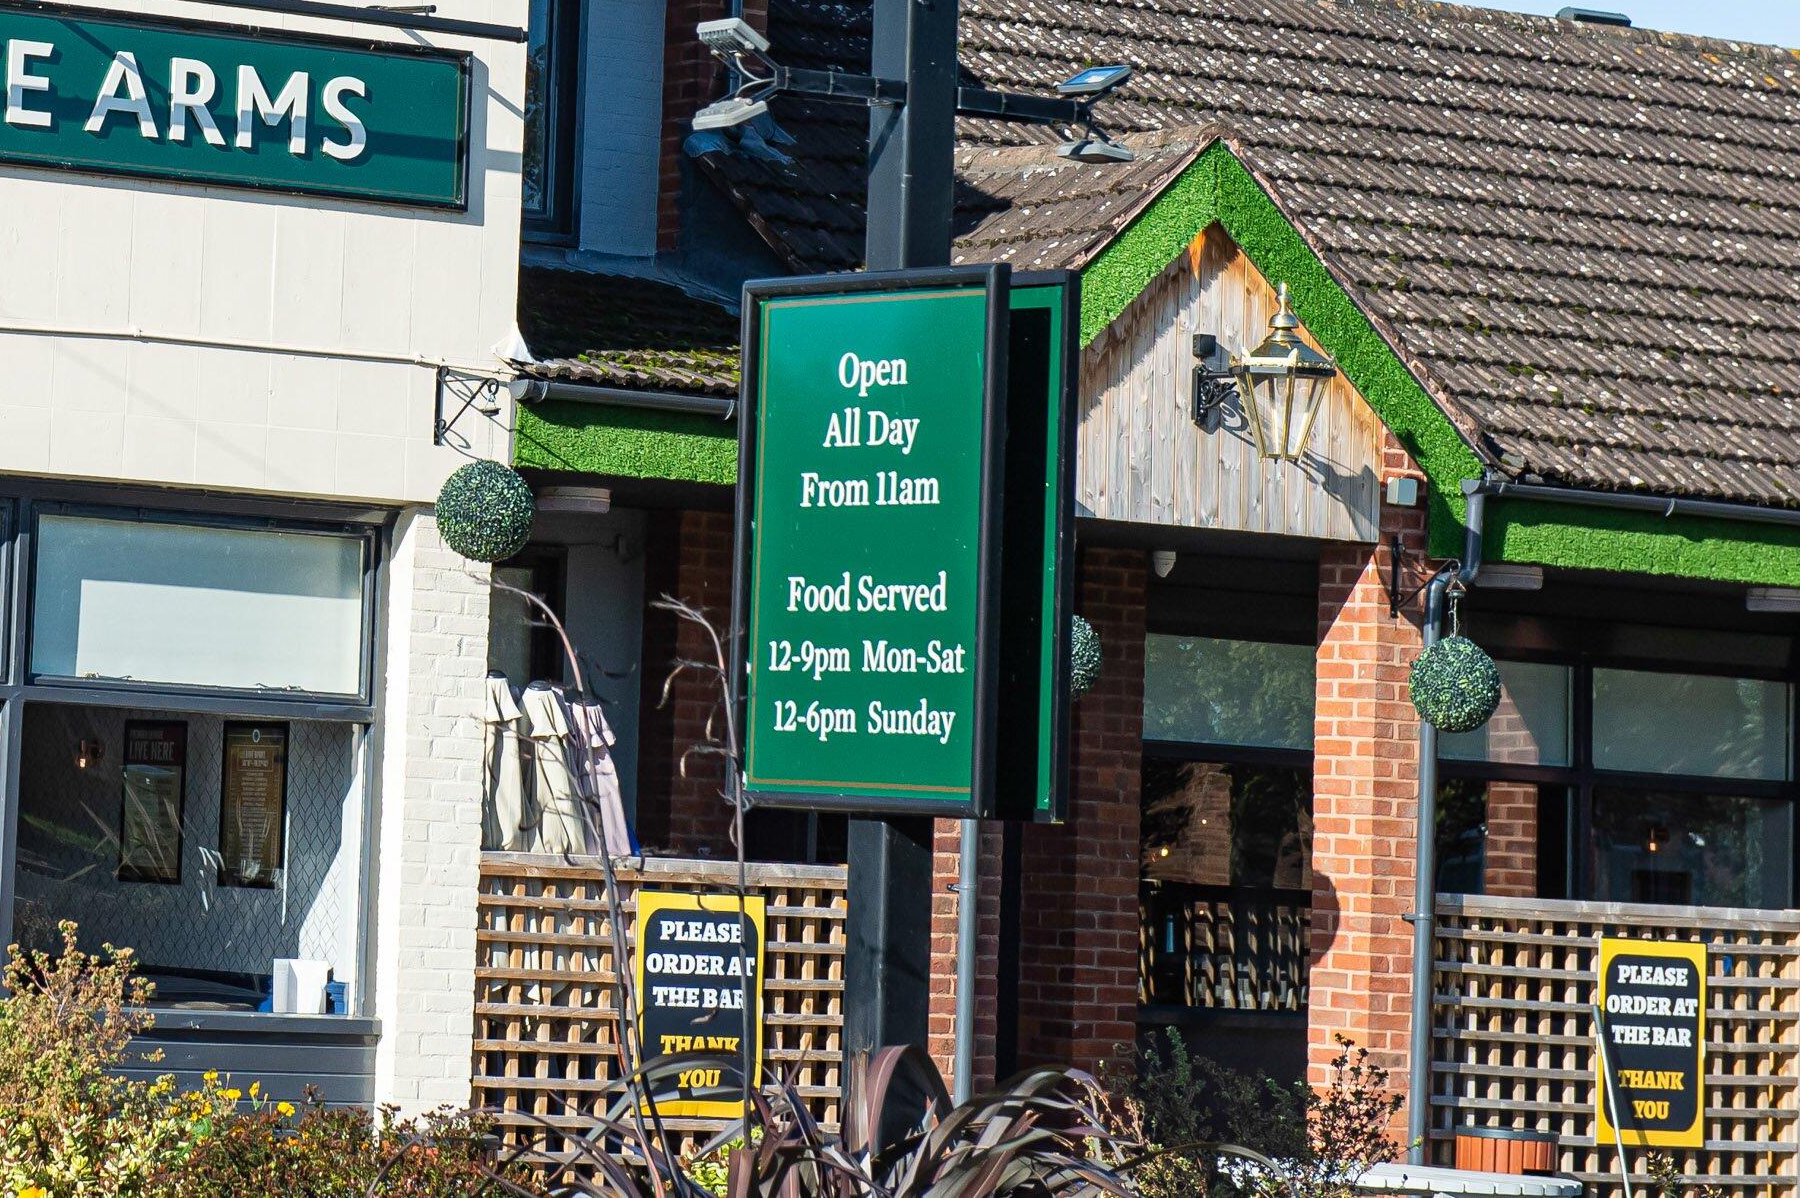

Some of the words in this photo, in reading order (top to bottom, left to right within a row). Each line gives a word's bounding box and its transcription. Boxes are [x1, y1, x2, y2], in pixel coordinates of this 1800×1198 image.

[84, 50, 368, 161] ARMS
[838, 352, 908, 397] Open
[822, 407, 861, 448] All
[866, 410, 920, 455] Day
[800, 472, 869, 508] From
[875, 472, 940, 506] 11am
[786, 572, 851, 612] Food
[857, 571, 947, 612] Served
[768, 639, 851, 681] 12-9pm
[861, 639, 966, 674] Mon-Sat
[773, 700, 857, 742] 12-6pm
[866, 698, 956, 744] Sunday
[659, 920, 743, 943] PLEASE
[646, 952, 724, 976] ORDER
[726, 956, 756, 977] AT
[1617, 964, 1689, 987] PLEASE
[652, 986, 700, 1008] THE
[702, 988, 745, 1010] BAR
[1606, 994, 1673, 1017] ORDER
[1673, 998, 1699, 1018] AT
[660, 1034, 741, 1055] THANK
[1611, 1024, 1650, 1045] THE
[1651, 1026, 1692, 1048] BAR
[677, 1068, 722, 1088] YOU
[1618, 1069, 1685, 1091] THANK
[1632, 1100, 1670, 1120] YOU
